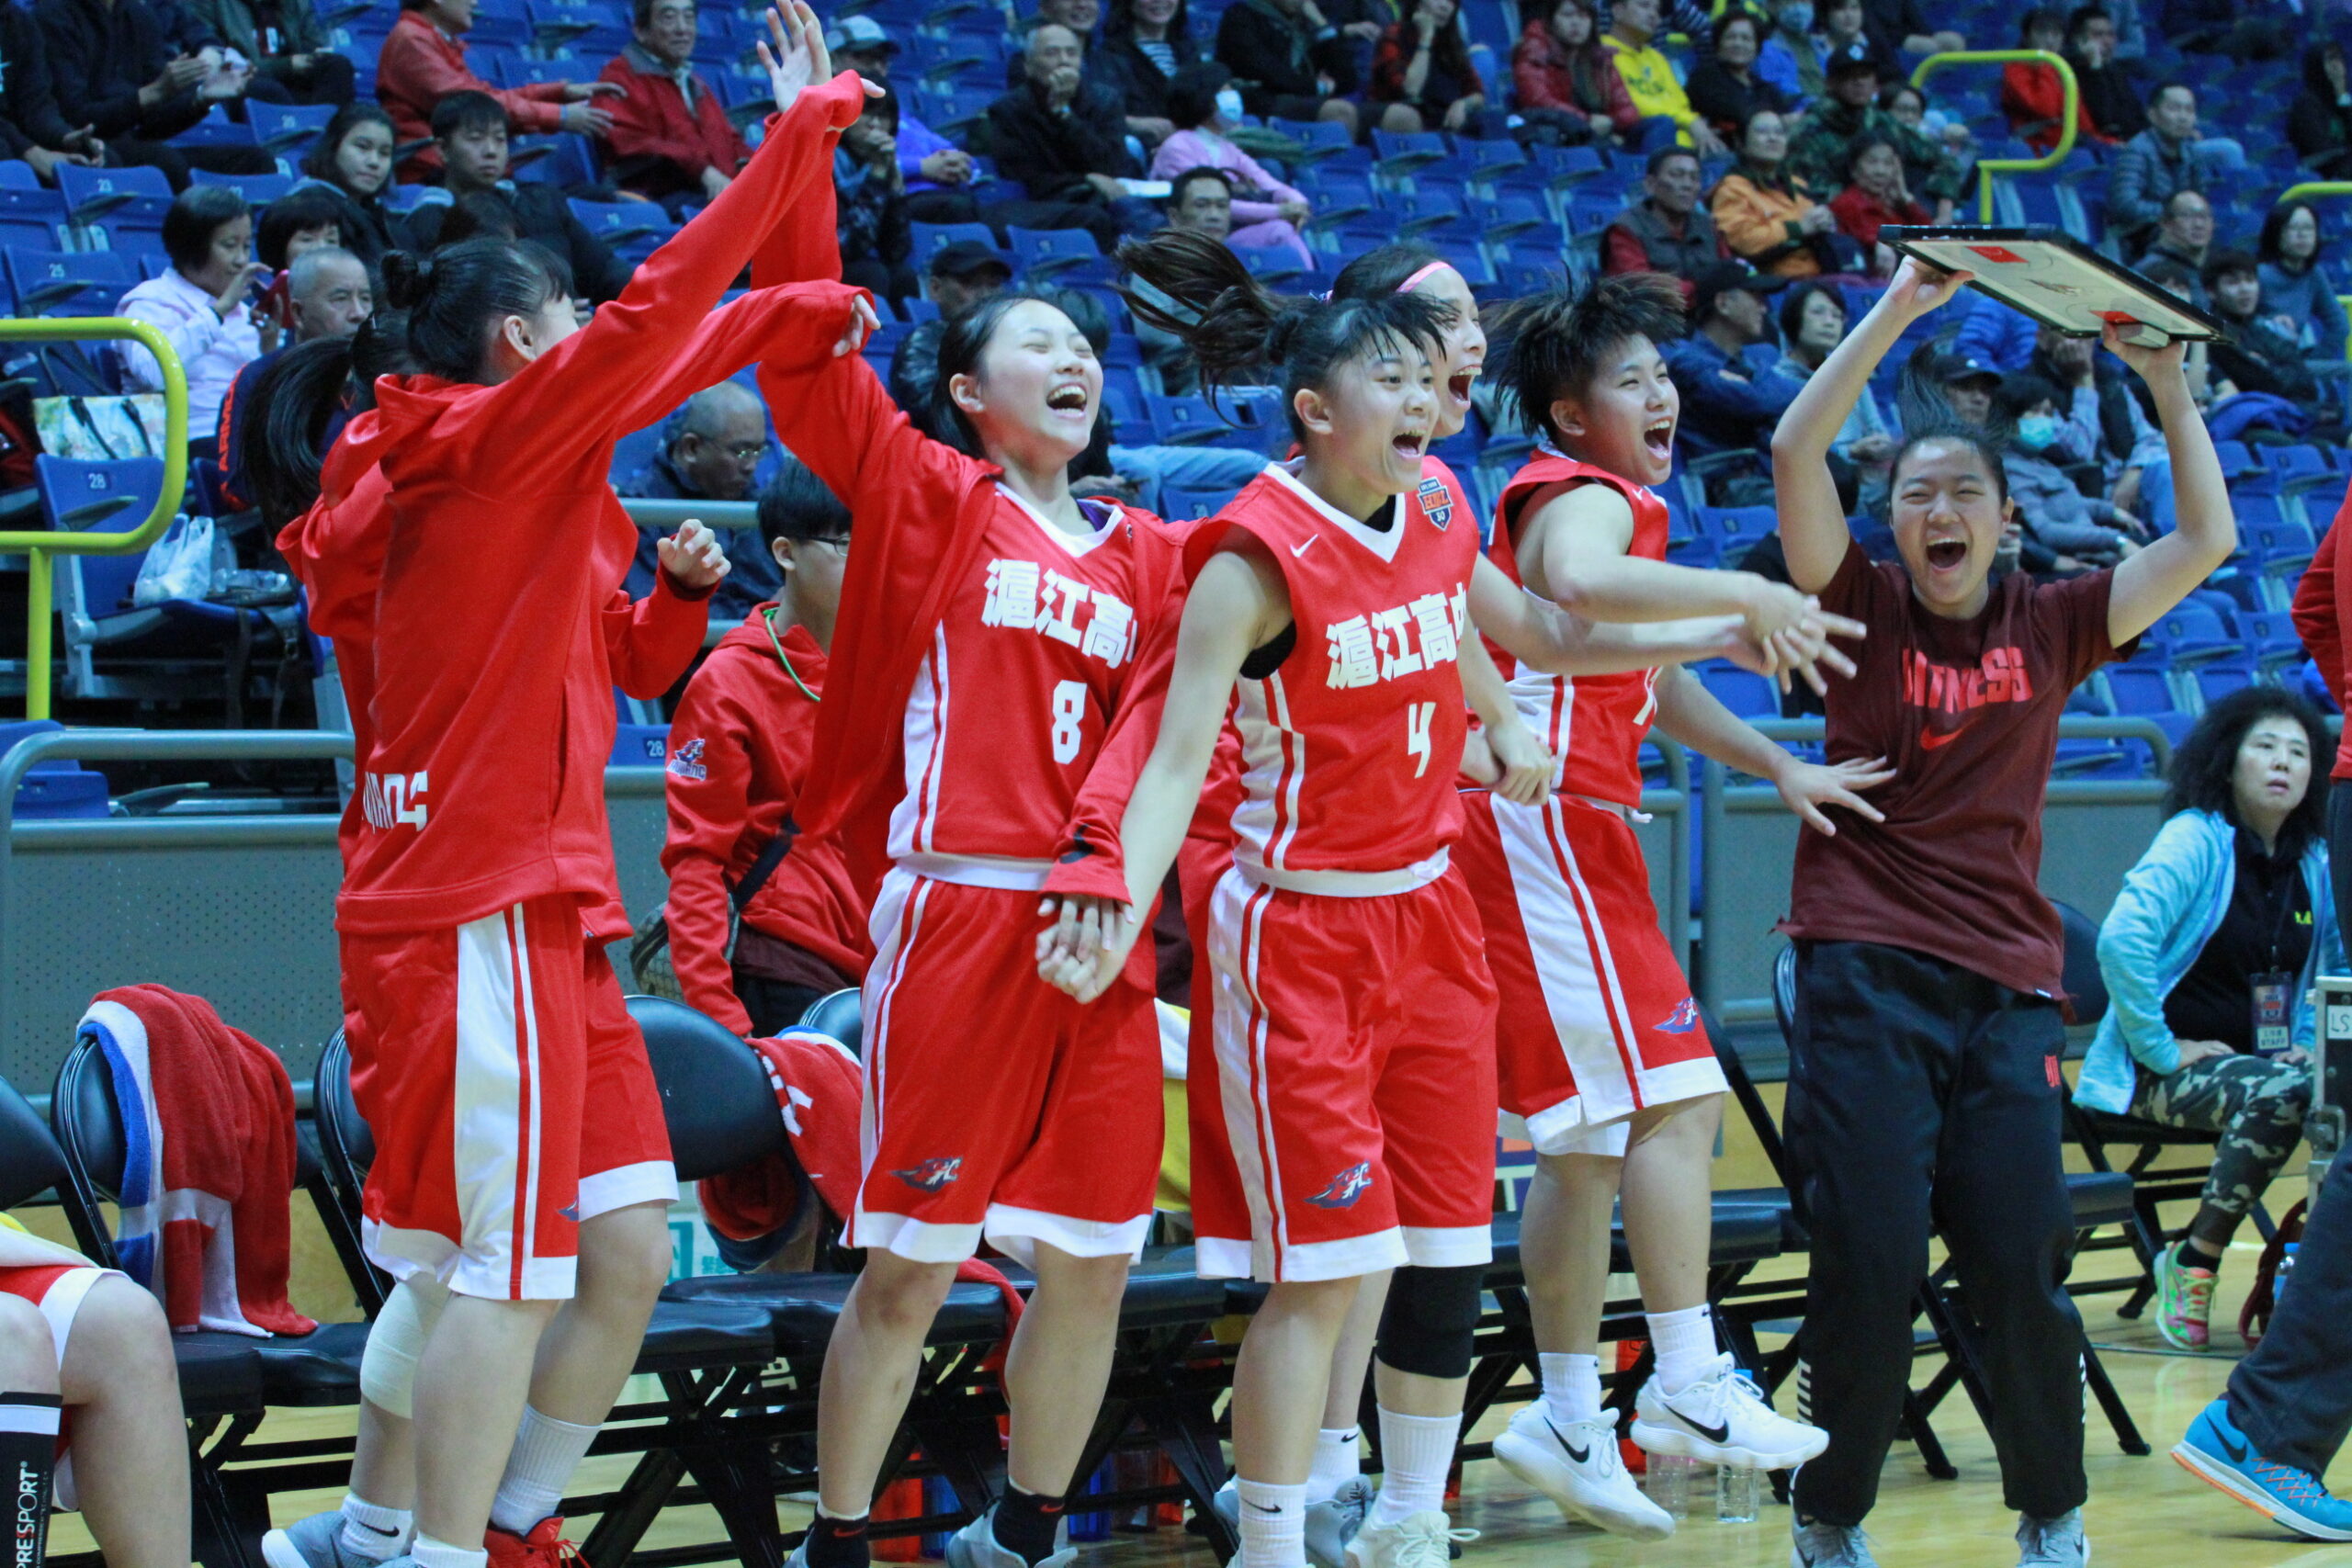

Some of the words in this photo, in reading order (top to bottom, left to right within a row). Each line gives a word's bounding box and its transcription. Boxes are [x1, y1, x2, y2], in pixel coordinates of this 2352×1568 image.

[88, 472, 107, 490] 28
[981, 558, 1137, 669] 滬江高
[646, 739, 666, 758] 28
[1052, 680, 1088, 765] 8
[1408, 702, 1437, 779] 4
